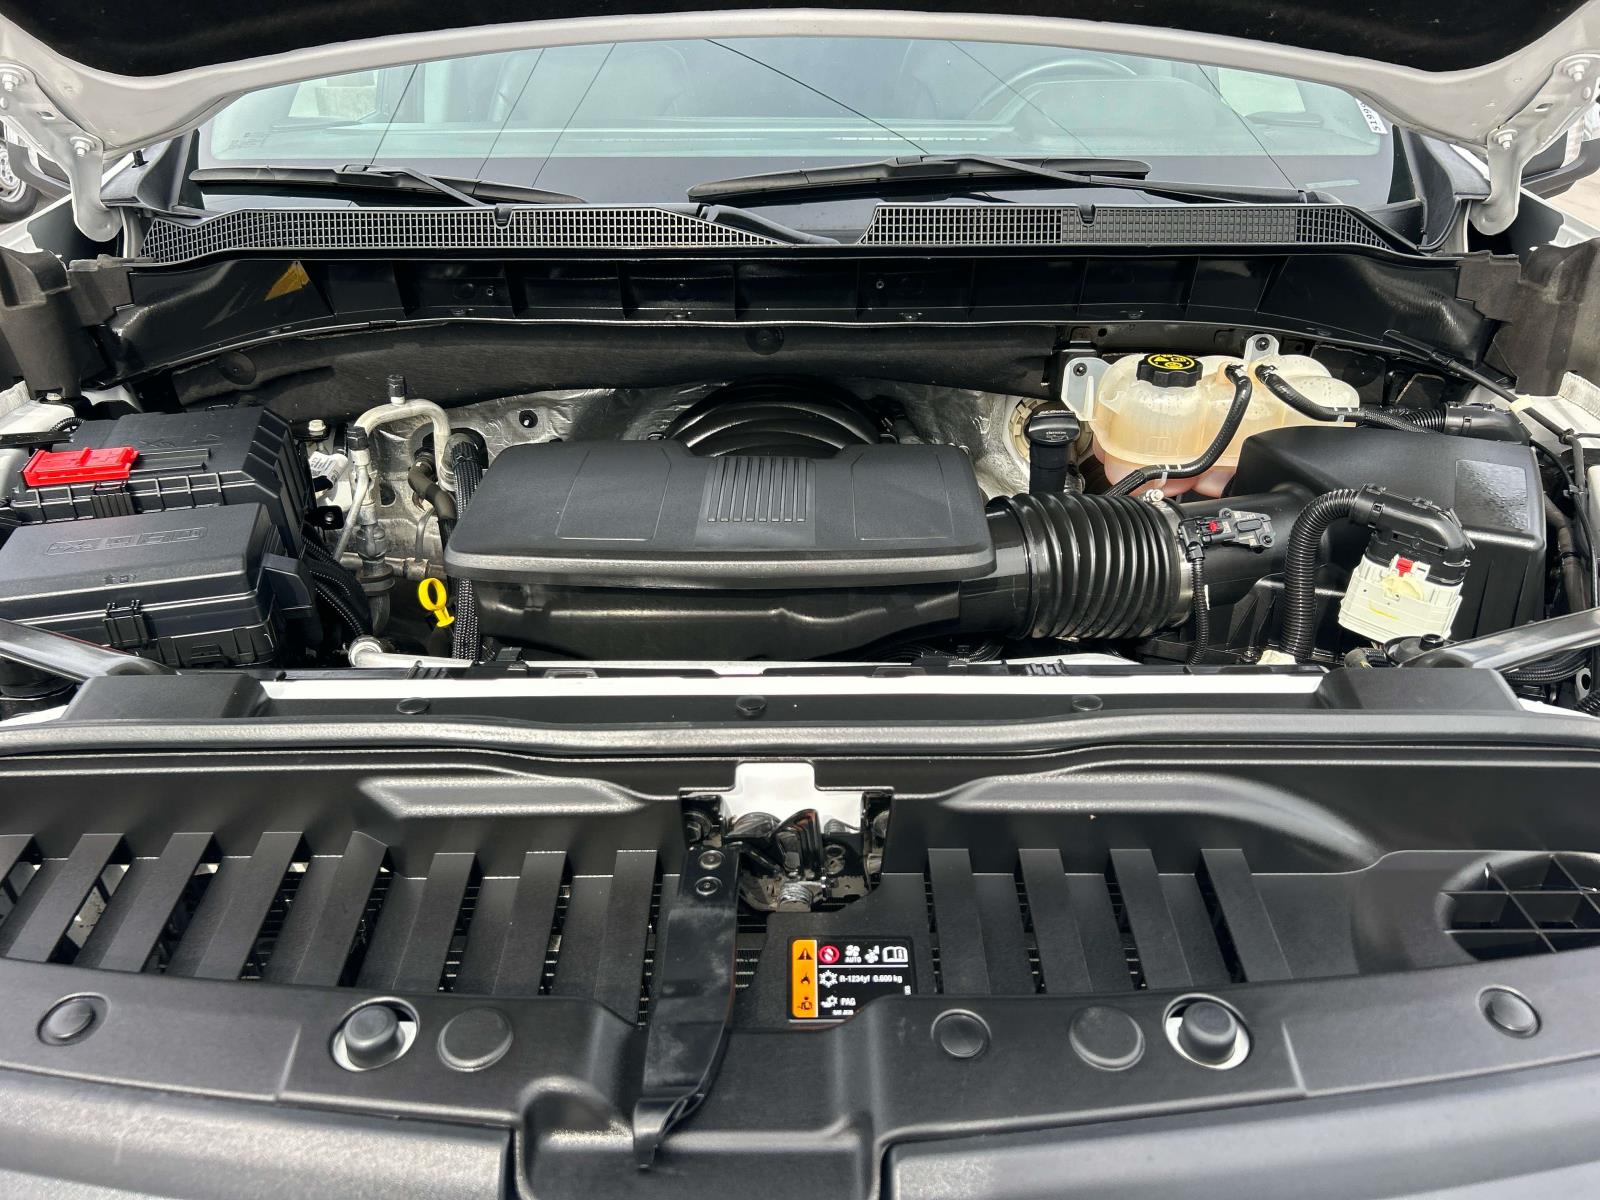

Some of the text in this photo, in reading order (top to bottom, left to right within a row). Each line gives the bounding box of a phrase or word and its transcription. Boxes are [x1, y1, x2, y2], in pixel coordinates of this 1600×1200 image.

[839, 975, 870, 984] R-1234yf
[893, 975, 903, 984] kg
[840, 998, 856, 1006] PAG
